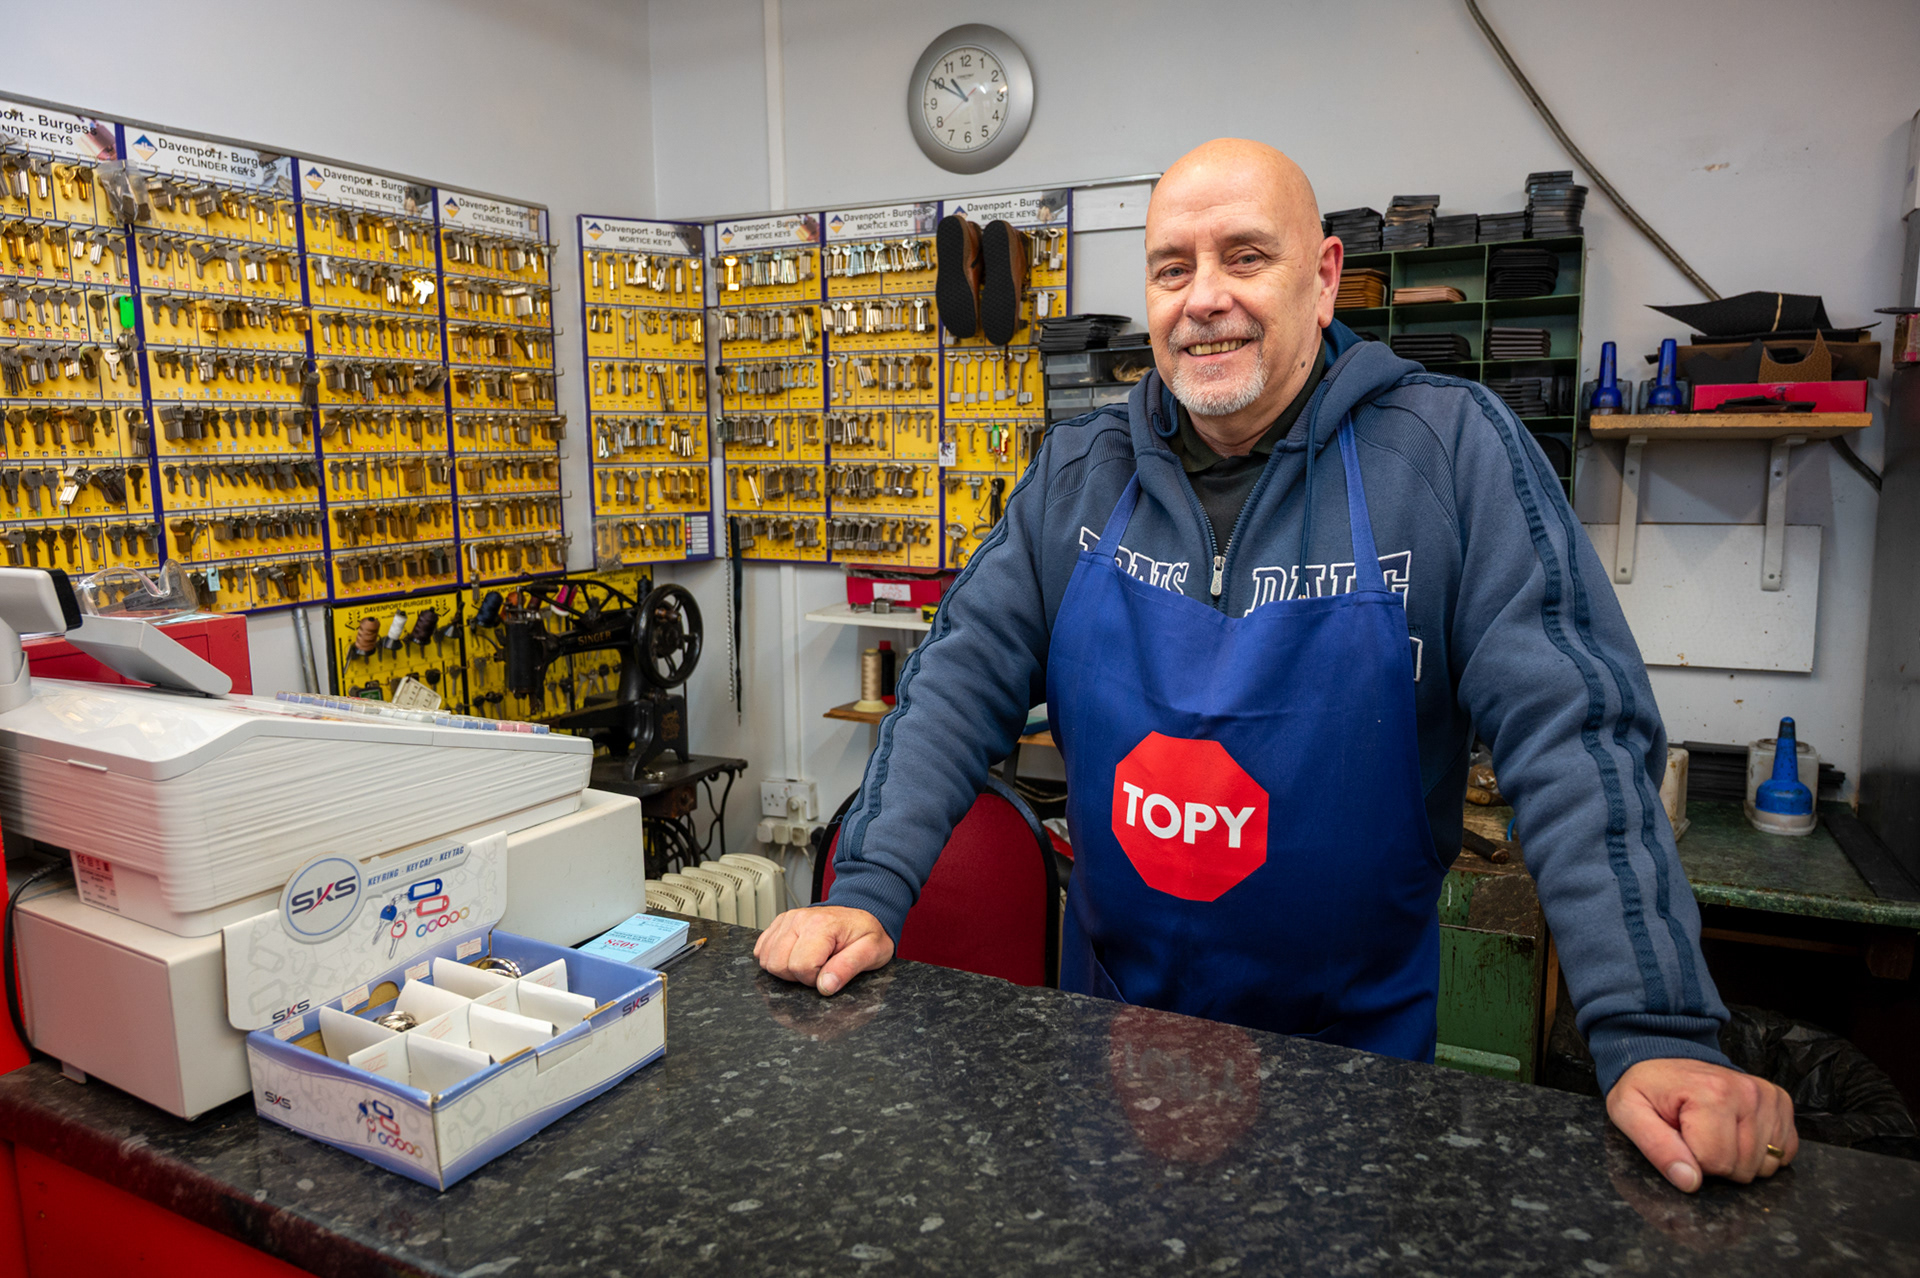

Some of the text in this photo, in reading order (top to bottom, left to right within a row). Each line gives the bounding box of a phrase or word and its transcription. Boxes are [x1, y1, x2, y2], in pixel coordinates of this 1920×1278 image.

[944, 61, 954, 74] 11
[960, 54, 972, 68] 12
[991, 69, 999, 82] 2
[934, 77, 945, 90] 10
[996, 89, 1005, 103] 3
[930, 98, 938, 110] 9
[992, 109, 1000, 121] 4
[38, 114, 97, 136] Burgess
[936, 116, 944, 128] 8
[948, 129, 956, 141] 7
[964, 131, 972, 143] 6
[981, 125, 989, 138] 5
[41, 131, 73, 146] KEYS
[177, 155, 228, 173] CYLINDER
[230, 165, 256, 178] KEYS
[231, 151, 277, 171] Burgess
[340, 184, 381, 199] CYLINDER
[382, 192, 403, 203] KEYS
[967, 200, 1011, 212] Davenport
[472, 212, 506, 225] CYLINDER
[506, 218, 523, 228] KEYS
[844, 211, 885, 222] Davenport
[981, 210, 1036, 220] MORTICE KEYS
[604, 223, 648, 236] Davenport
[733, 222, 770, 233] Davenport
[857, 220, 908, 230] MORTICE KEYS
[618, 236, 672, 247] MORTICE KEYS
[745, 230, 791, 240] MORTICE KEYS
[364, 599, 432, 614] DAVENPORT-BURGESS
[578, 631, 611, 645] SINGER
[1122, 781, 1256, 848] TOPY
[367, 846, 464, 887] KEY RING KEY CAP KEY TAG
[291, 875, 356, 915] SKS
[272, 999, 310, 1024] SKS
[622, 993, 649, 1017] SKS
[265, 1091, 292, 1110] SKS
